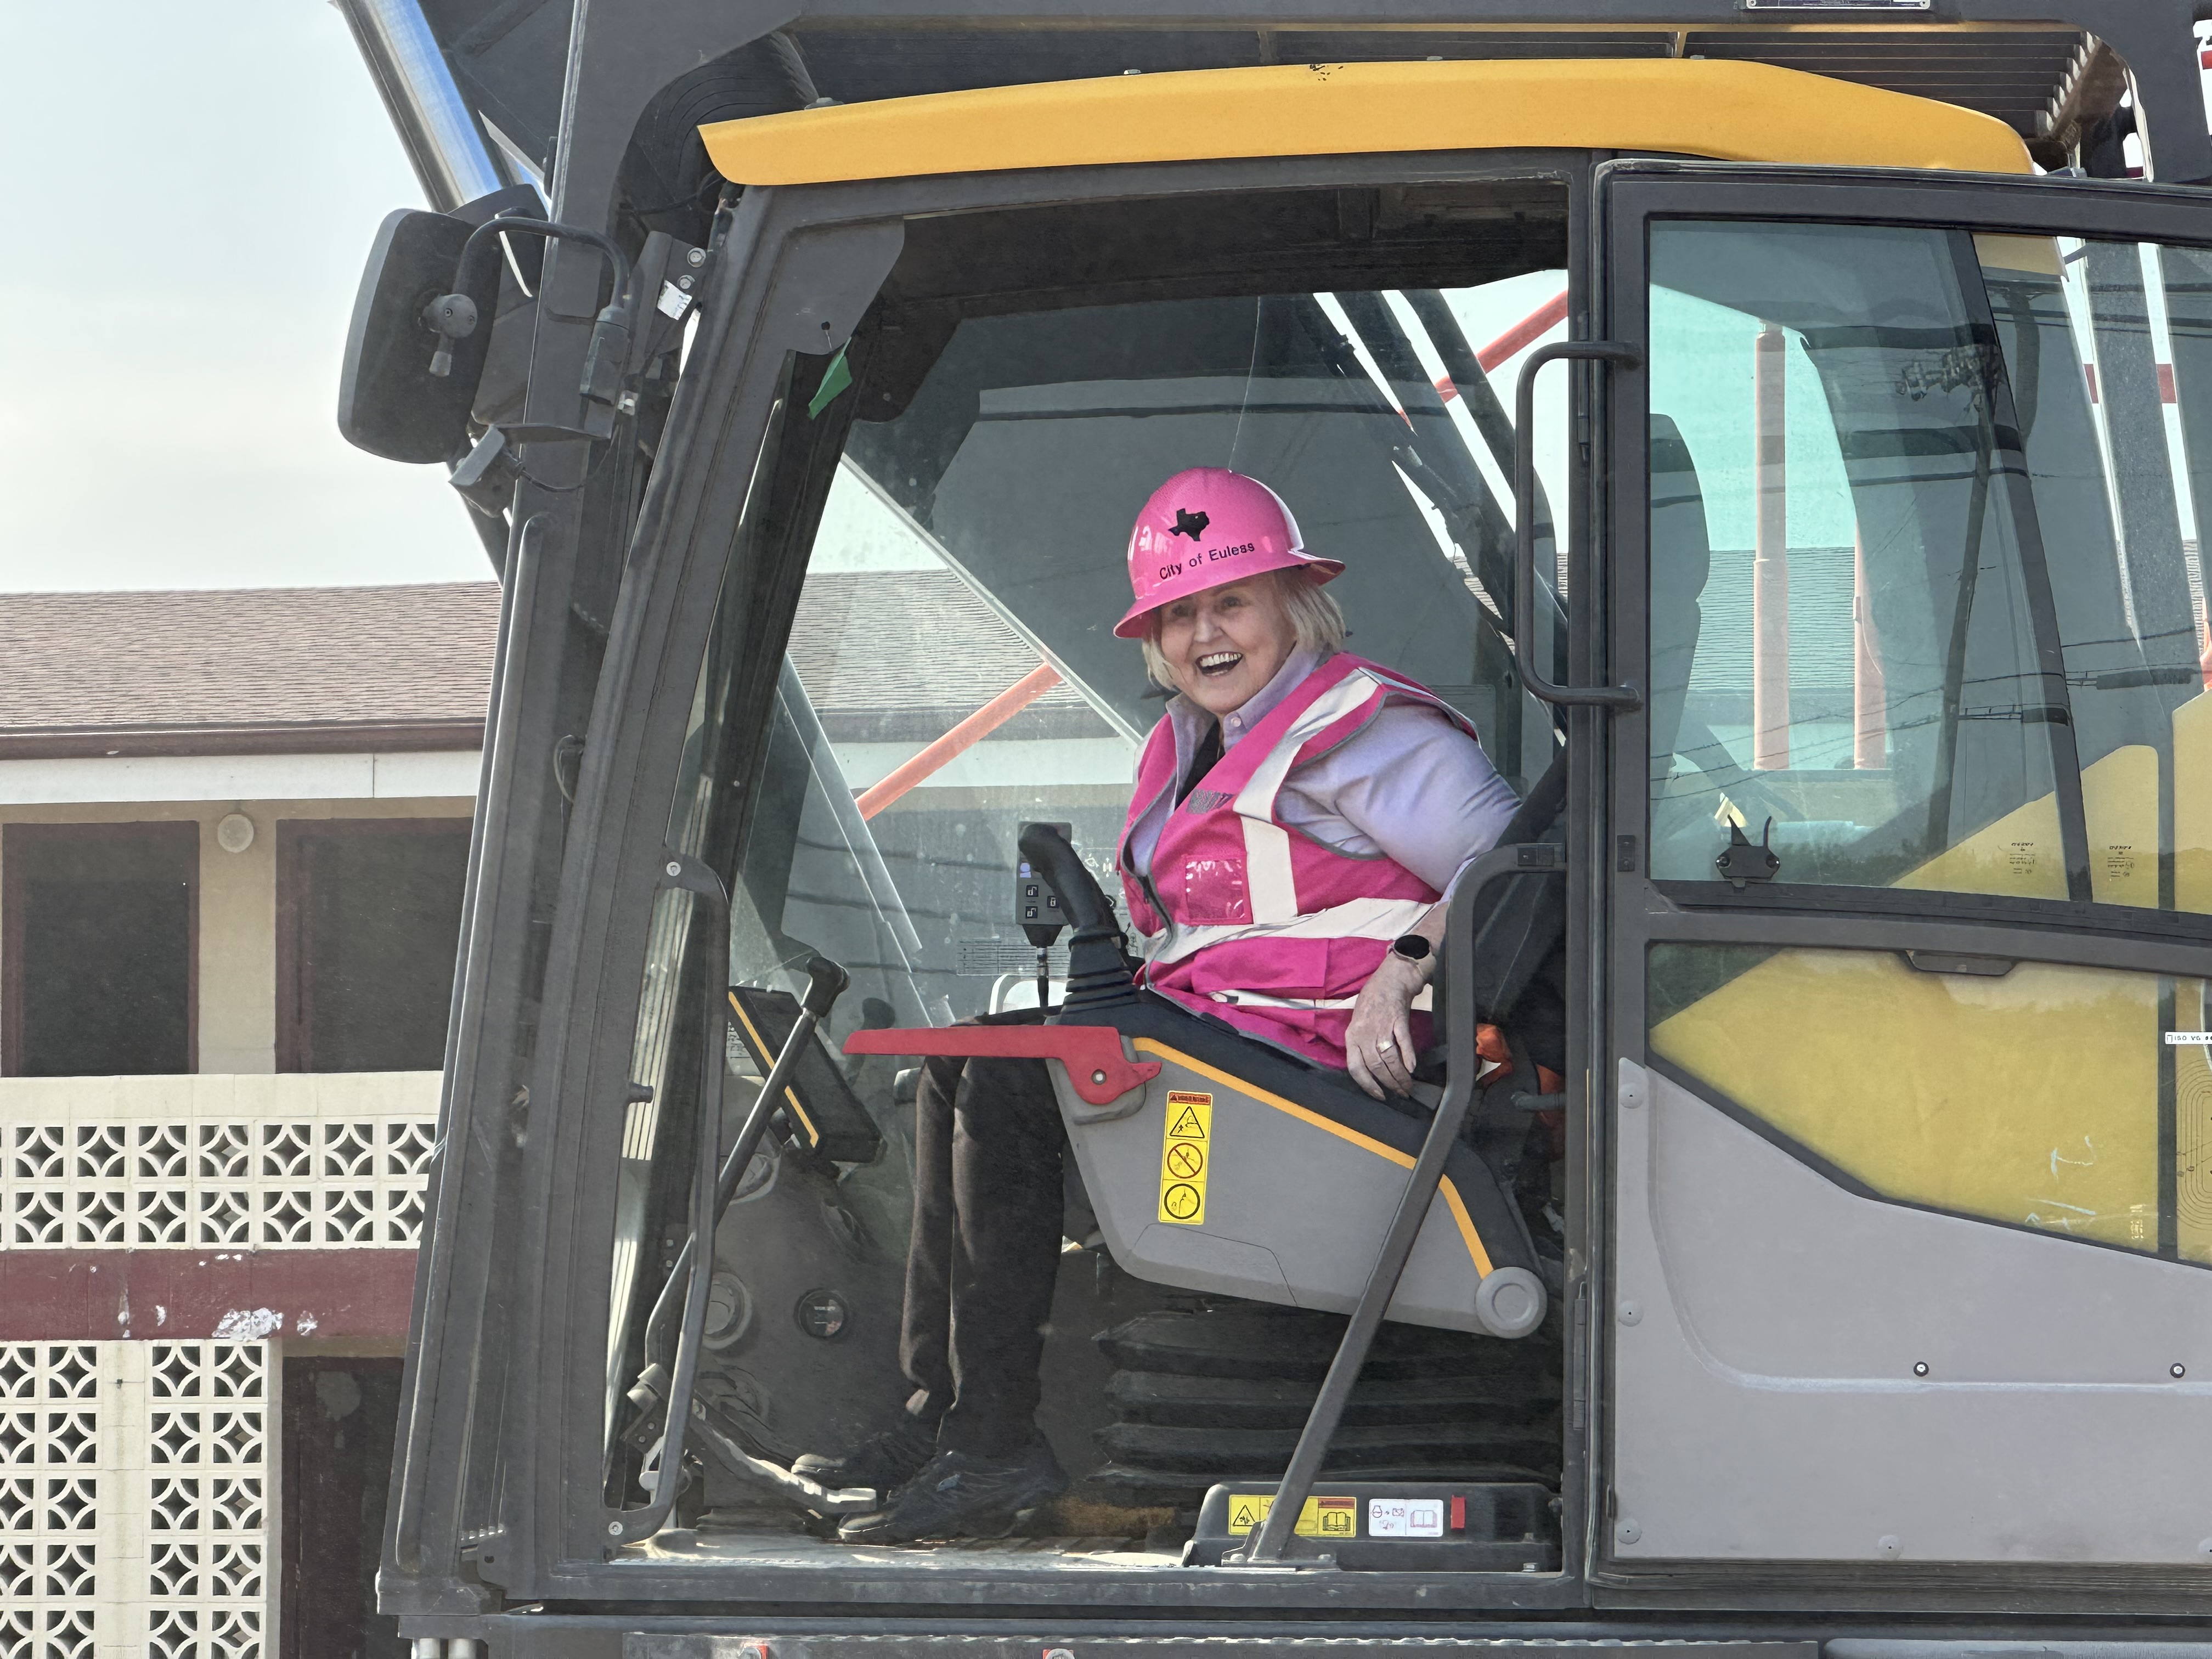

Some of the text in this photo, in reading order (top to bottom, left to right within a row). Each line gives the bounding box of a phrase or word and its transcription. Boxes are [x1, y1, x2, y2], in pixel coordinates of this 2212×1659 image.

[1159, 543, 1255, 580] City of Euless
